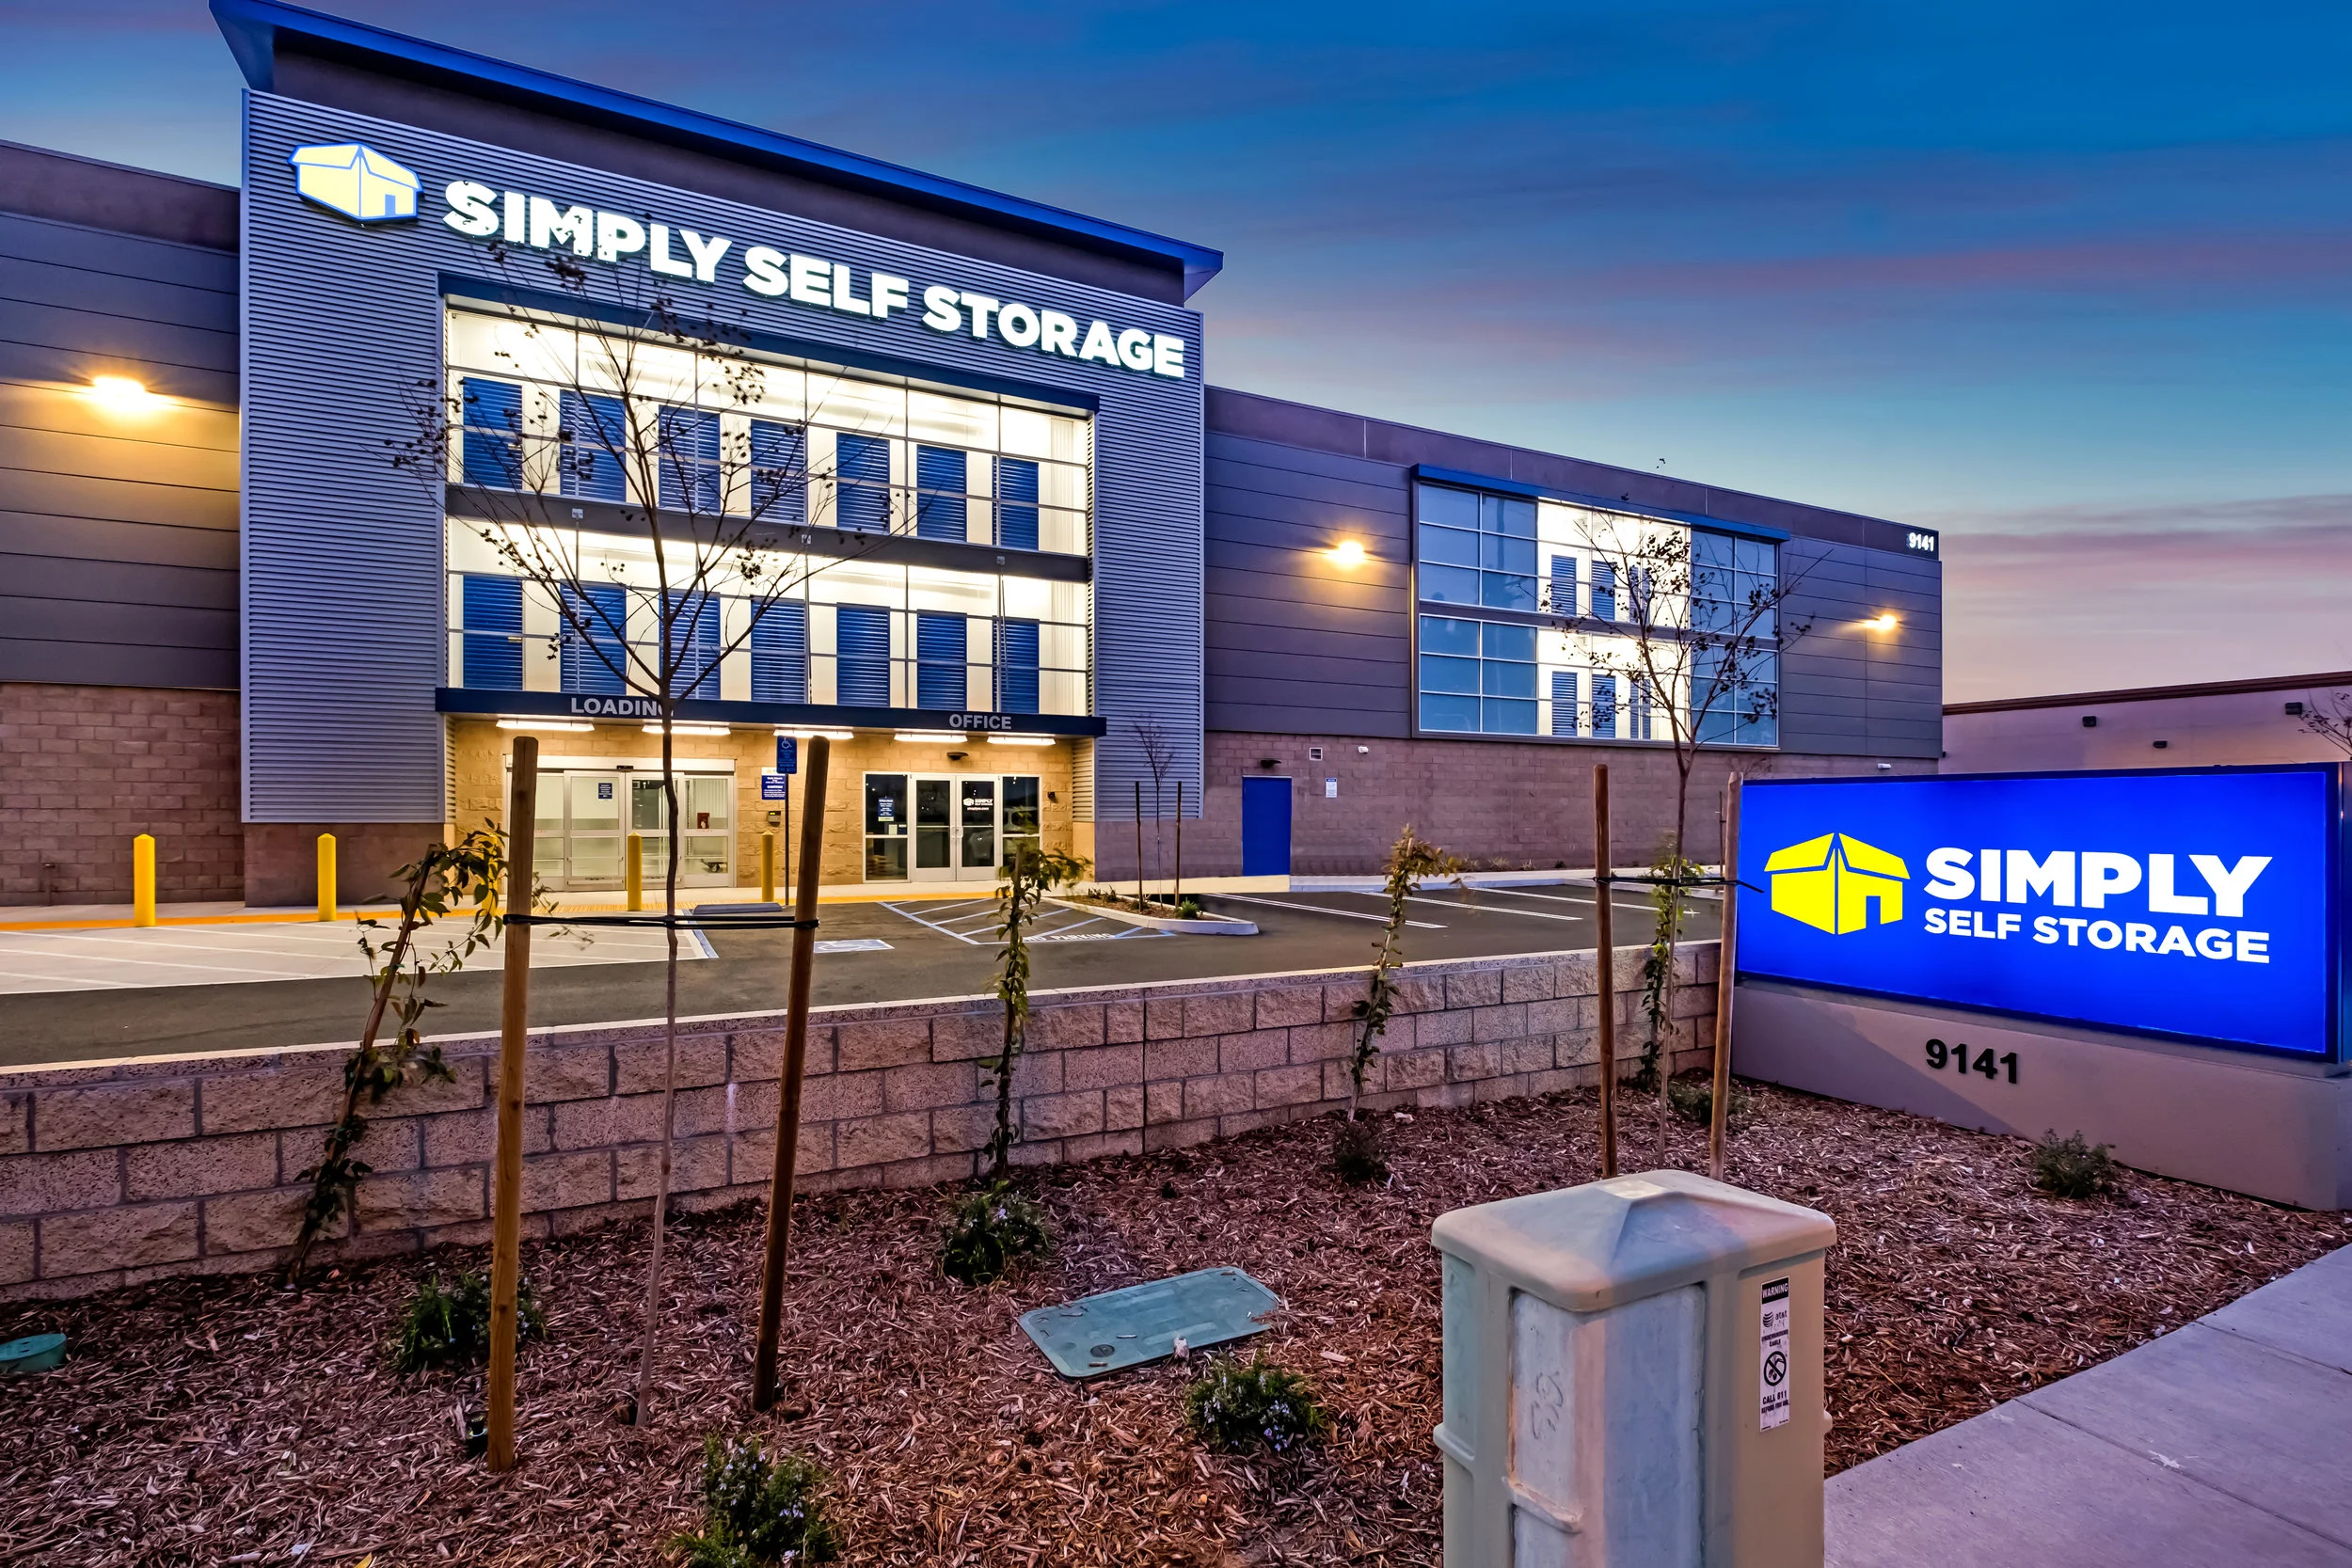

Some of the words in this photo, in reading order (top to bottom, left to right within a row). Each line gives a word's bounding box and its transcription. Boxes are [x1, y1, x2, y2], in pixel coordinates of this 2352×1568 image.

[443, 181, 733, 283] SIMPLY
[743, 246, 910, 319] SELF
[922, 286, 1184, 378] STORAGE
[1908, 532, 1934, 552] 9141
[949, 714, 1011, 730] OFFICE
[1924, 847, 2273, 918] SIMPLY
[1924, 908, 2021, 940] SELF
[2032, 915, 2270, 964] STORAGE
[1926, 1038, 2018, 1085] 9141
[1762, 1282, 1788, 1299] WARNING
[1762, 1393, 1775, 1405] CALL
[1777, 1389, 1788, 1401] 811
